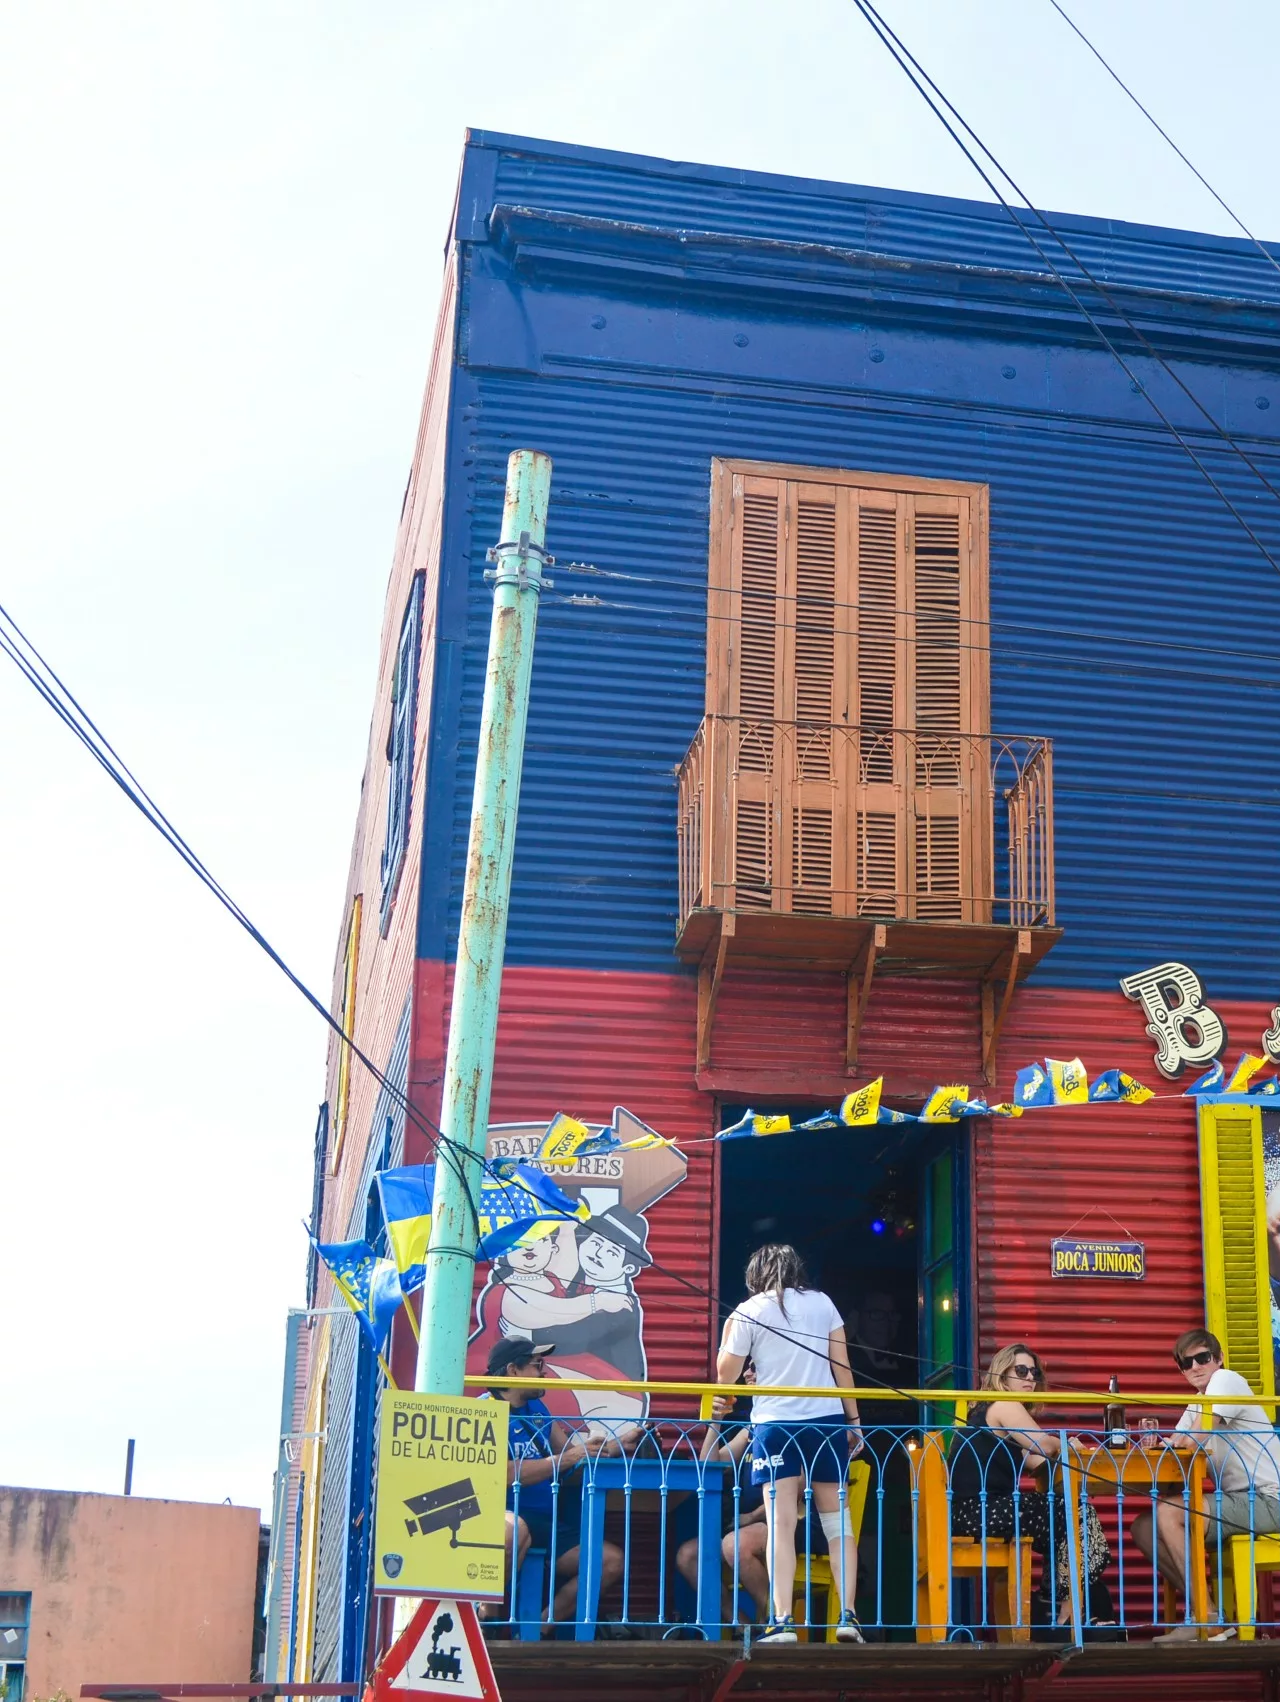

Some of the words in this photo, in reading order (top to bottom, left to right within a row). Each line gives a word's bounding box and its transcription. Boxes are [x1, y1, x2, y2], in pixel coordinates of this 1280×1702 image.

[1075, 1244, 1121, 1252] AVENIDA
[1056, 1251, 1089, 1272] BOCA
[1092, 1252, 1142, 1273] JUNIORS
[393, 1401, 423, 1411] ESPACIO
[424, 1404, 472, 1416] MONITOREADO
[474, 1409, 488, 1417] POR
[392, 1411, 497, 1447] POLICIA
[391, 1440, 412, 1458] DE
[417, 1442, 436, 1459] LA
[440, 1444, 497, 1465] CIUDAD
